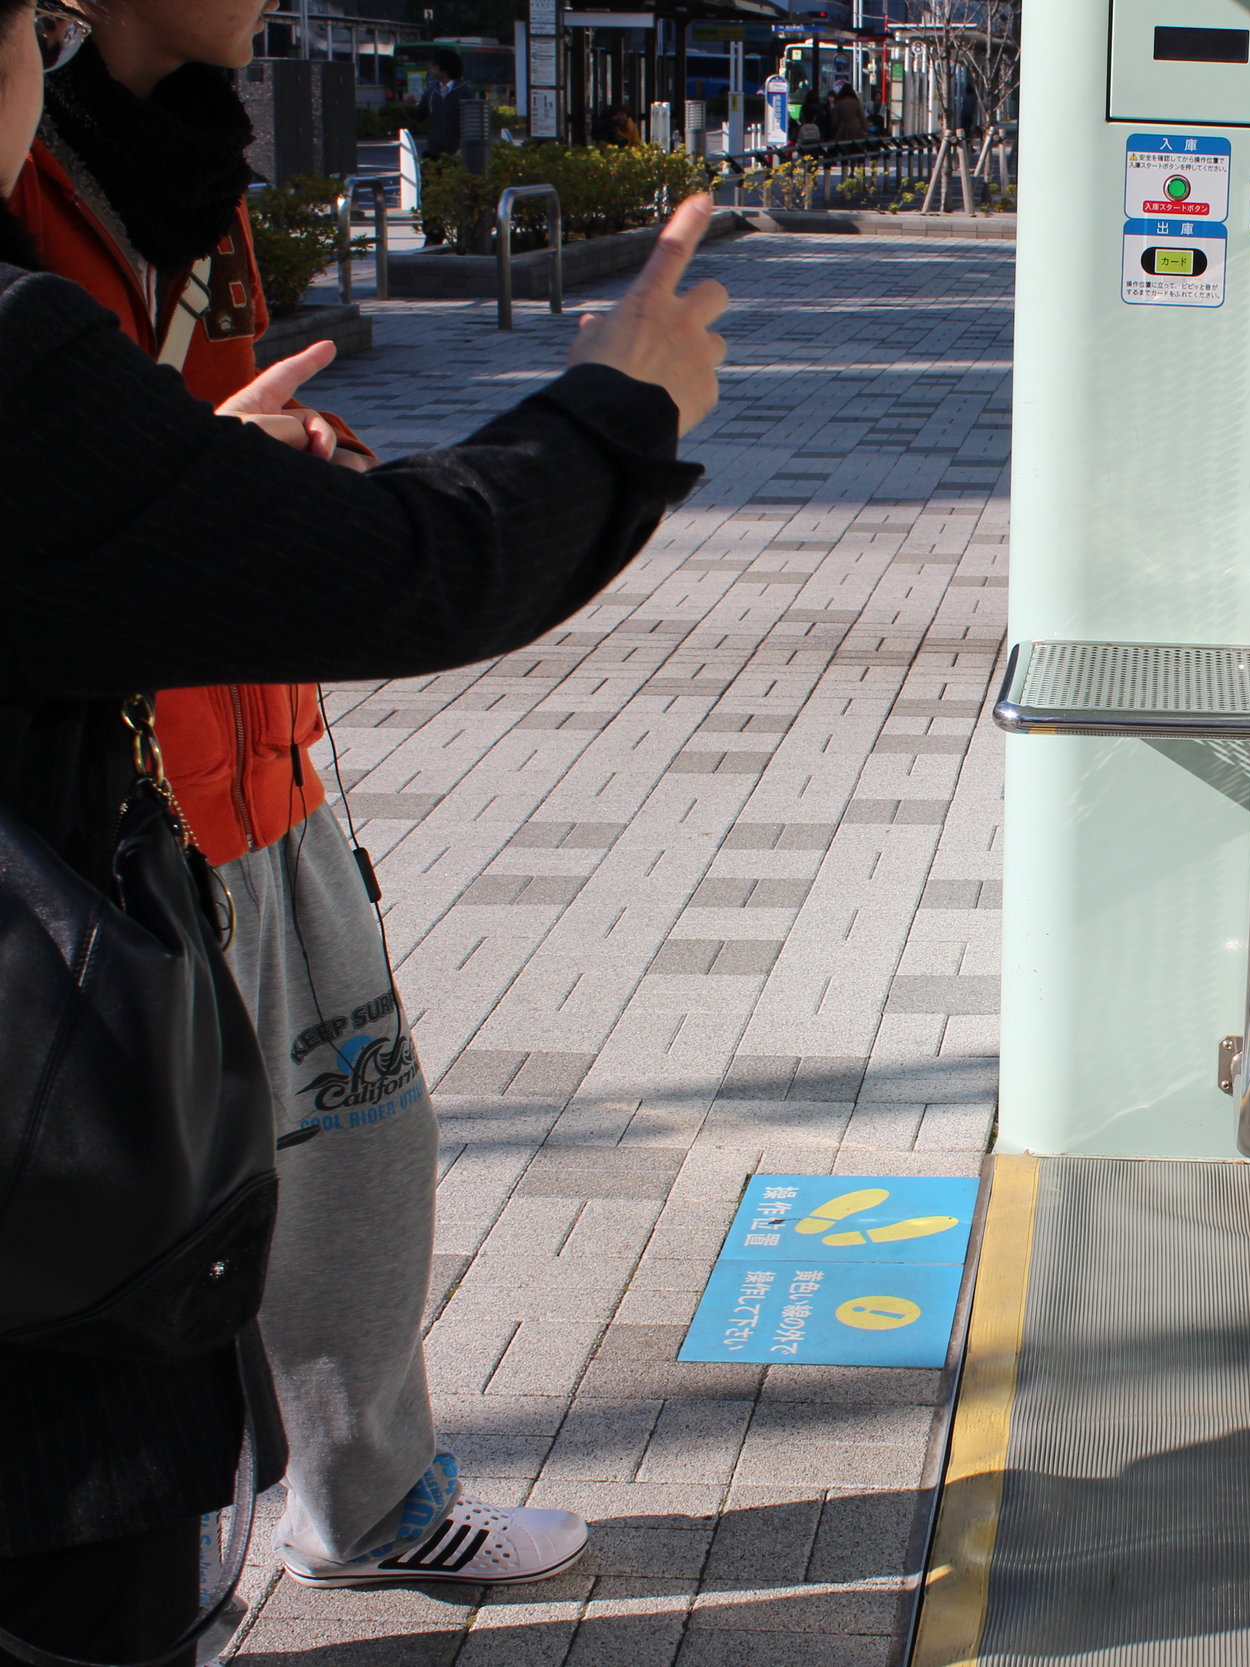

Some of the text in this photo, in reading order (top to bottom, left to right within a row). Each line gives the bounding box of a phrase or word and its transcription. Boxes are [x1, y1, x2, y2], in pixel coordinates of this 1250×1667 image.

[1160, 138, 1197, 151] 入庫
[1139, 154, 1225, 164] 安全を確認してから操作位置で
[1129, 162, 1227, 173] 入庫スタートボタンを押してください。
[1144, 203, 1208, 213] 入庫スタートボタン
[1156, 222, 1194, 235] 出庫
[1161, 257, 1187, 266] カード
[1126, 289, 1220, 300] するまでカードをふれてください。
[291, 1015, 349, 1066] KEEP
[348, 1100, 397, 1128] RIDER
[744, 1185, 800, 1247] 操作位置
[723, 1270, 777, 1352] 操作して下さい
[769, 1269, 825, 1356] 黄色い線の外で
